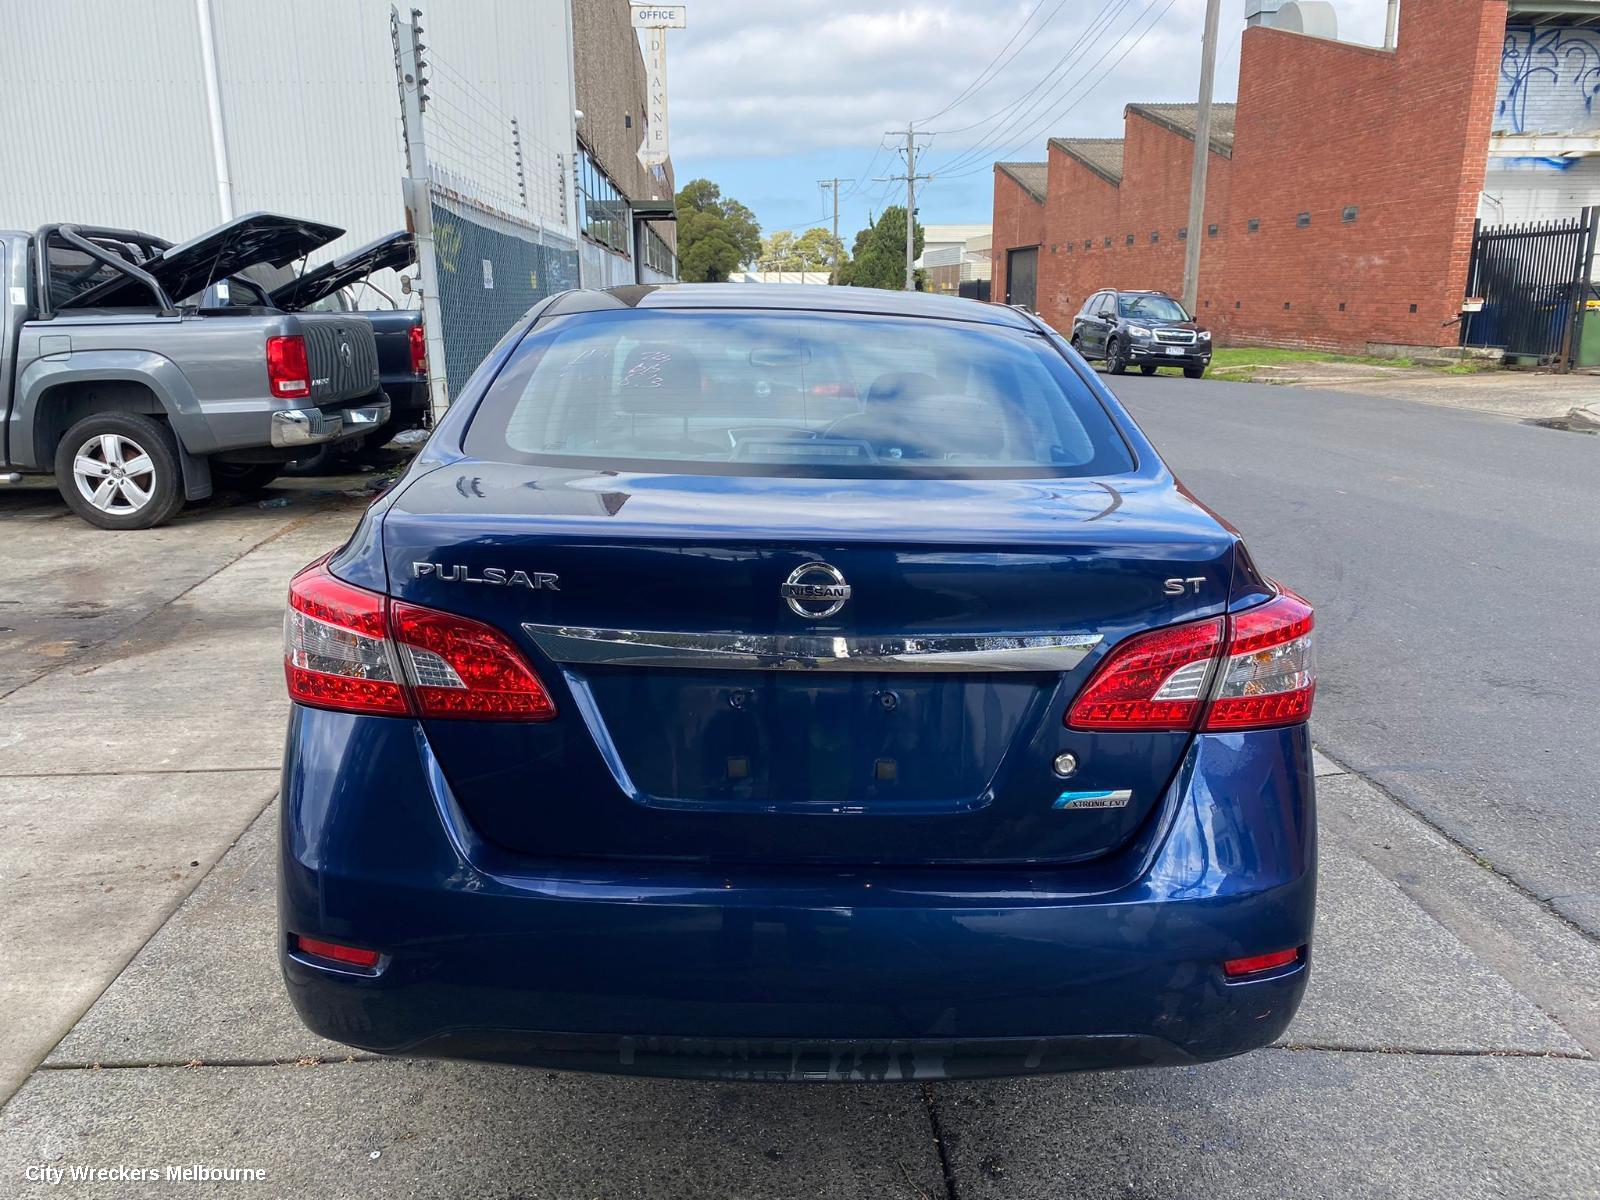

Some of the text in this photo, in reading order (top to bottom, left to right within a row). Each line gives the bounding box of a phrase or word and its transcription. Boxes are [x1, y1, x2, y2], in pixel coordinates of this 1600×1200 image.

[639, 11, 675, 20] OFFICE
[651, 40, 663, 141] DIANNE
[412, 561, 561, 591] PULSAR
[789, 586, 844, 597] NISSAN
[1163, 576, 1207, 595] ST
[1072, 800, 1108, 808] XTRONIC
